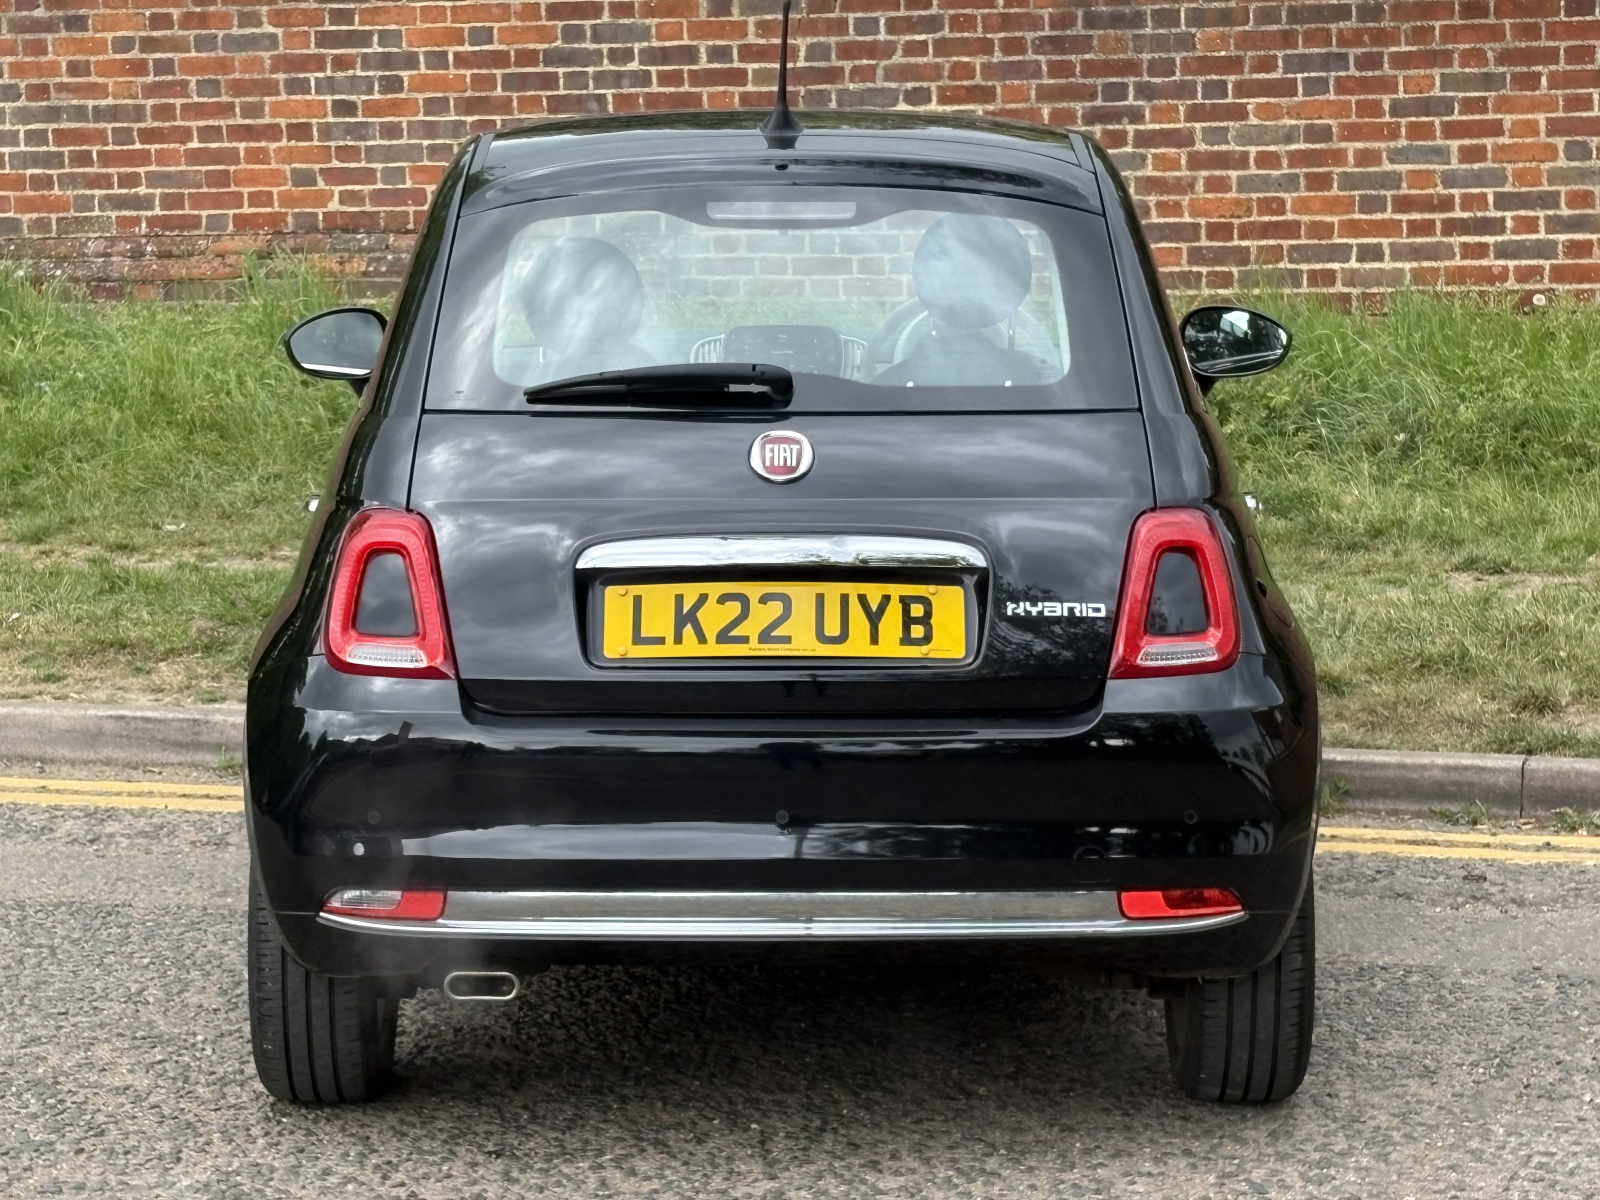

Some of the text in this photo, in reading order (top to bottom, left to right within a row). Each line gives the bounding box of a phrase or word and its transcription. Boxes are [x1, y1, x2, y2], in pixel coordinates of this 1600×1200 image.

[765, 443, 801, 467] FIAT
[631, 592, 934, 647] LK22 UYB
[1006, 601, 1106, 617] HYBRID
